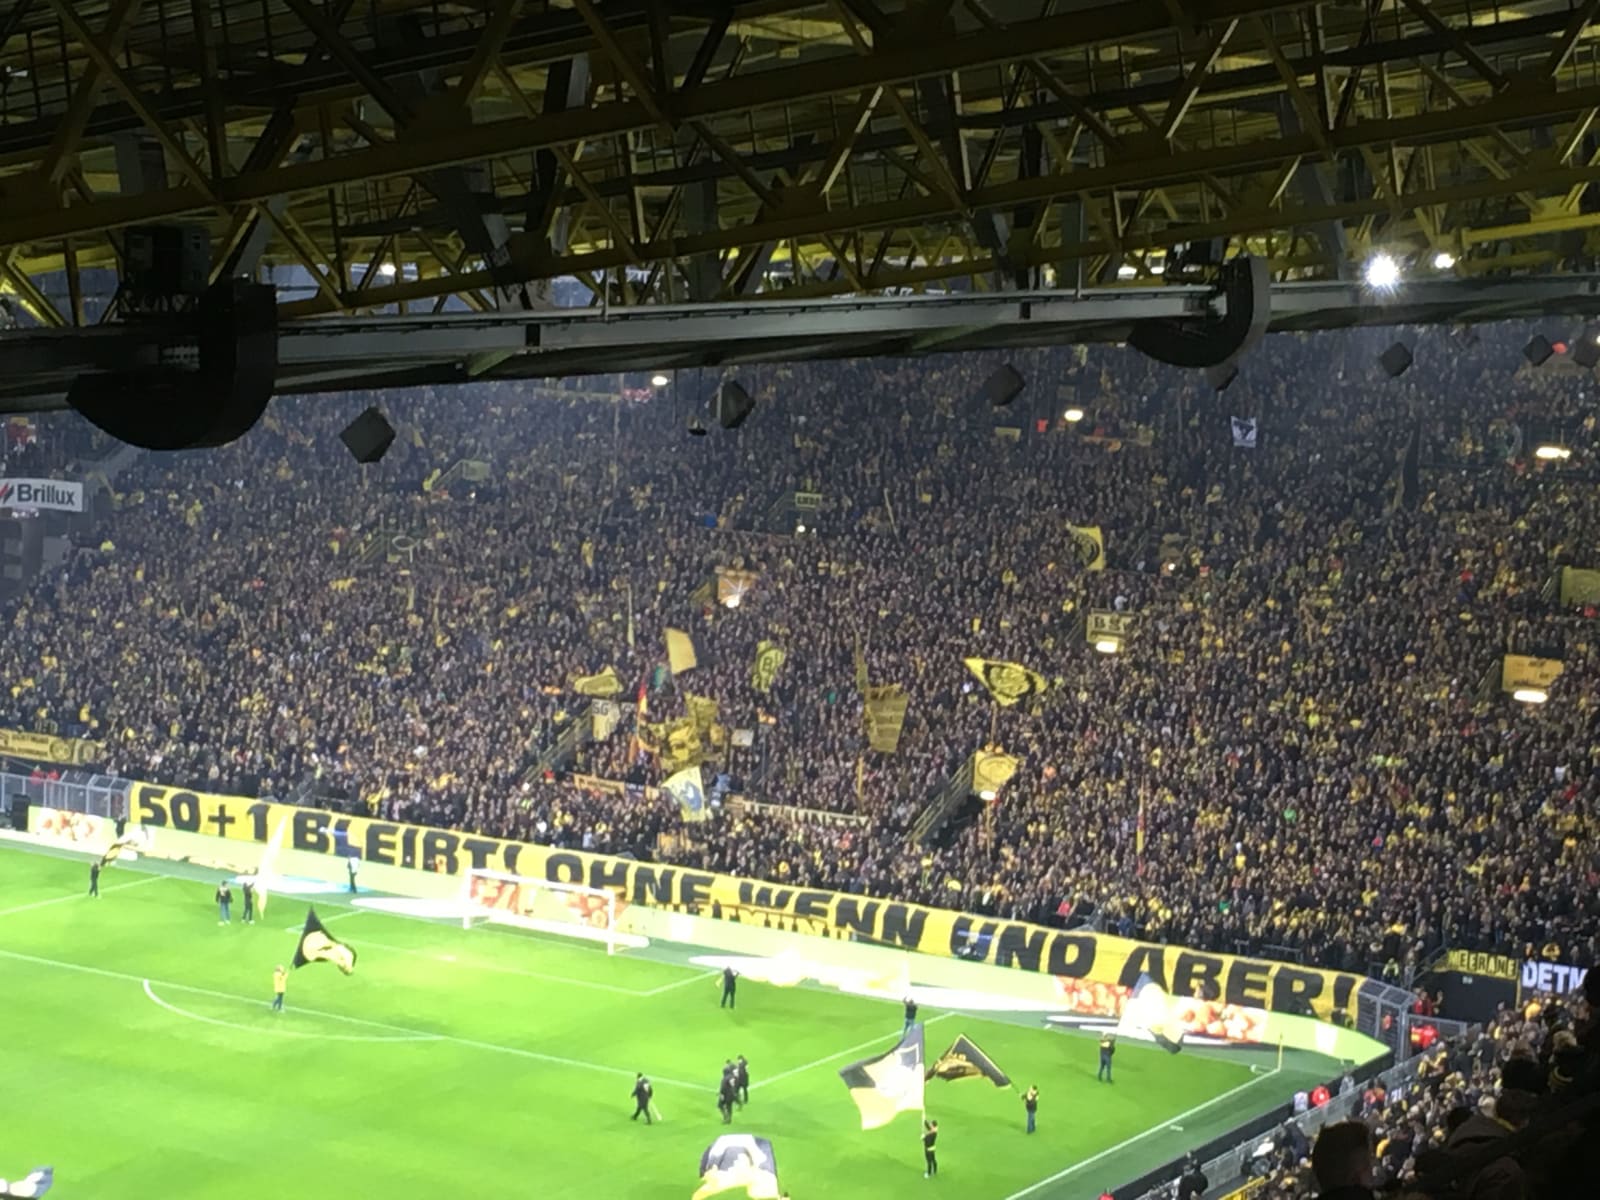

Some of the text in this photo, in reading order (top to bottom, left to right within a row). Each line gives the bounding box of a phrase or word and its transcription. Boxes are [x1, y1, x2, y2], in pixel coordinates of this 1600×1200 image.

[17, 483, 76, 506] Brillux
[139, 786, 271, 844] 50+1
[545, 852, 715, 907] OHNE
[738, 880, 929, 951] WENN
[949, 915, 1097, 979] UND
[1118, 945, 1356, 1027] ABER!
